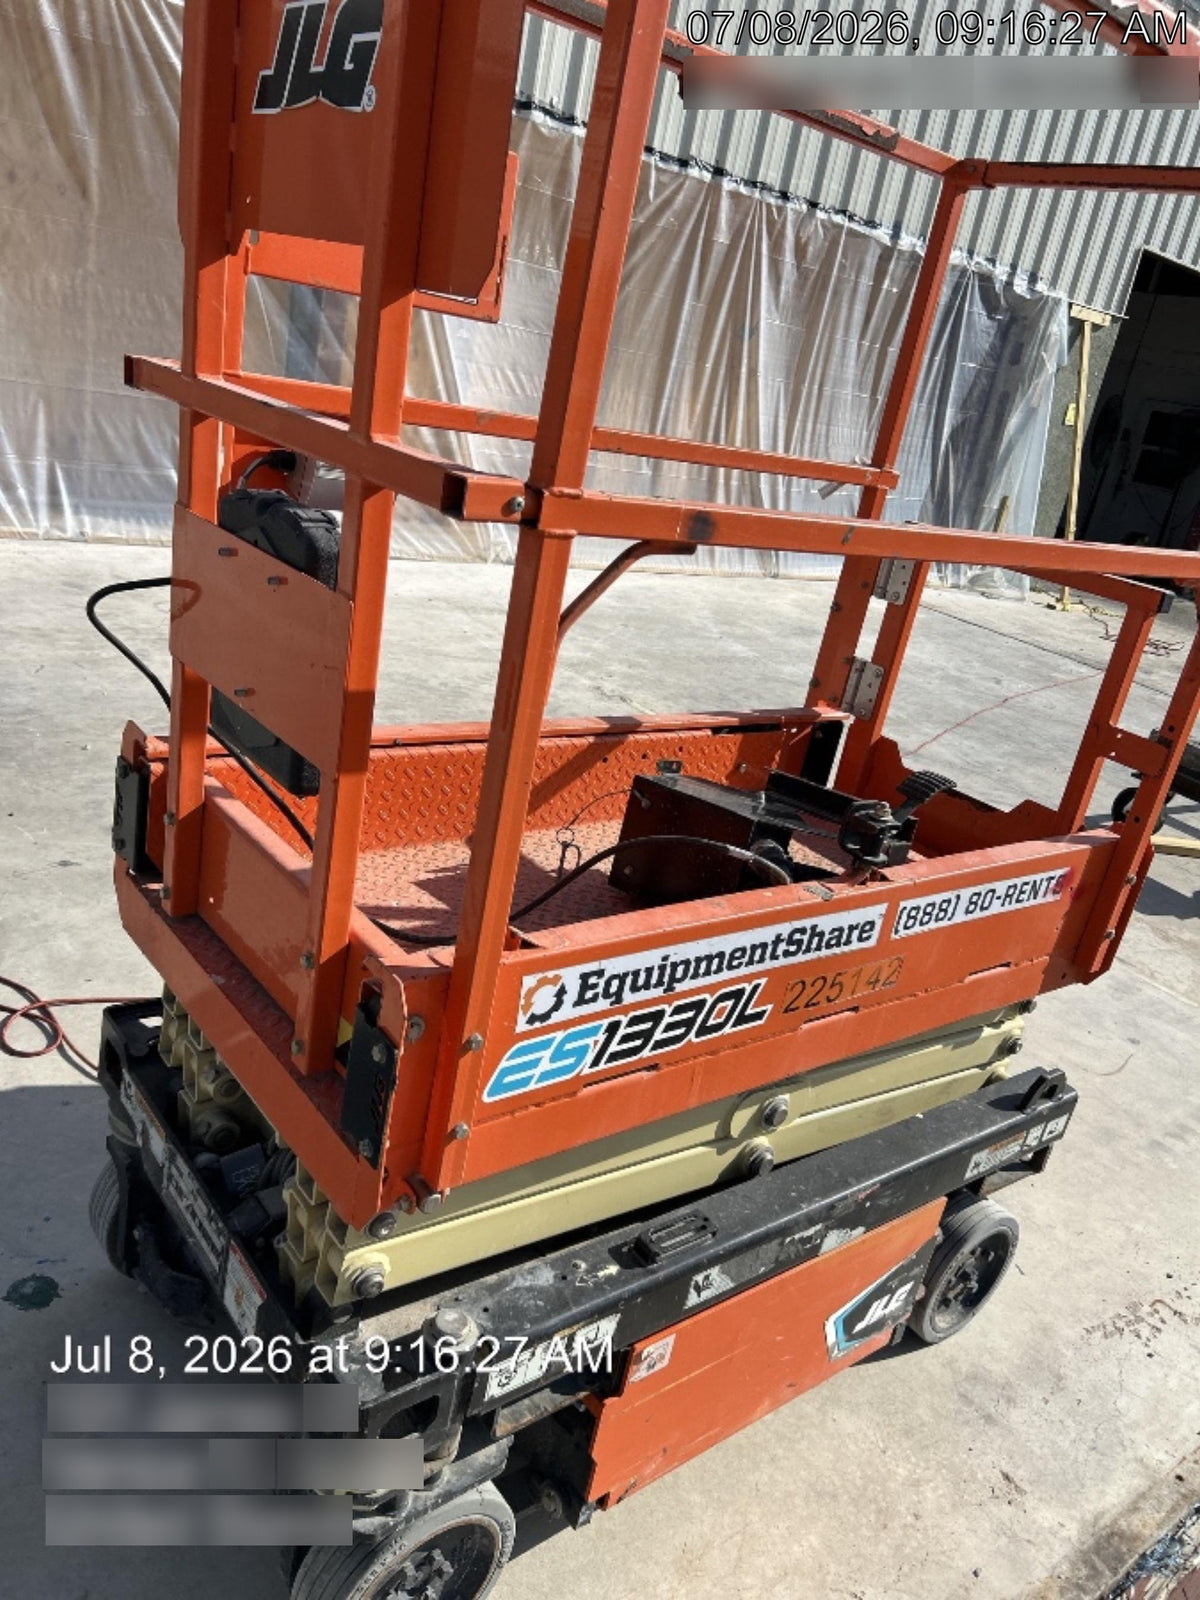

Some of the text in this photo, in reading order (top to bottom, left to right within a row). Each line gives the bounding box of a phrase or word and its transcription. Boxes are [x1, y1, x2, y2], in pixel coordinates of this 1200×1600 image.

[252, 0, 383, 114] JLG
[893, 893, 961, 935] (888)
[574, 917, 877, 1009] EquipmentShare
[782, 956, 904, 1014] 225142
[484, 978, 773, 1100] ES1330L
